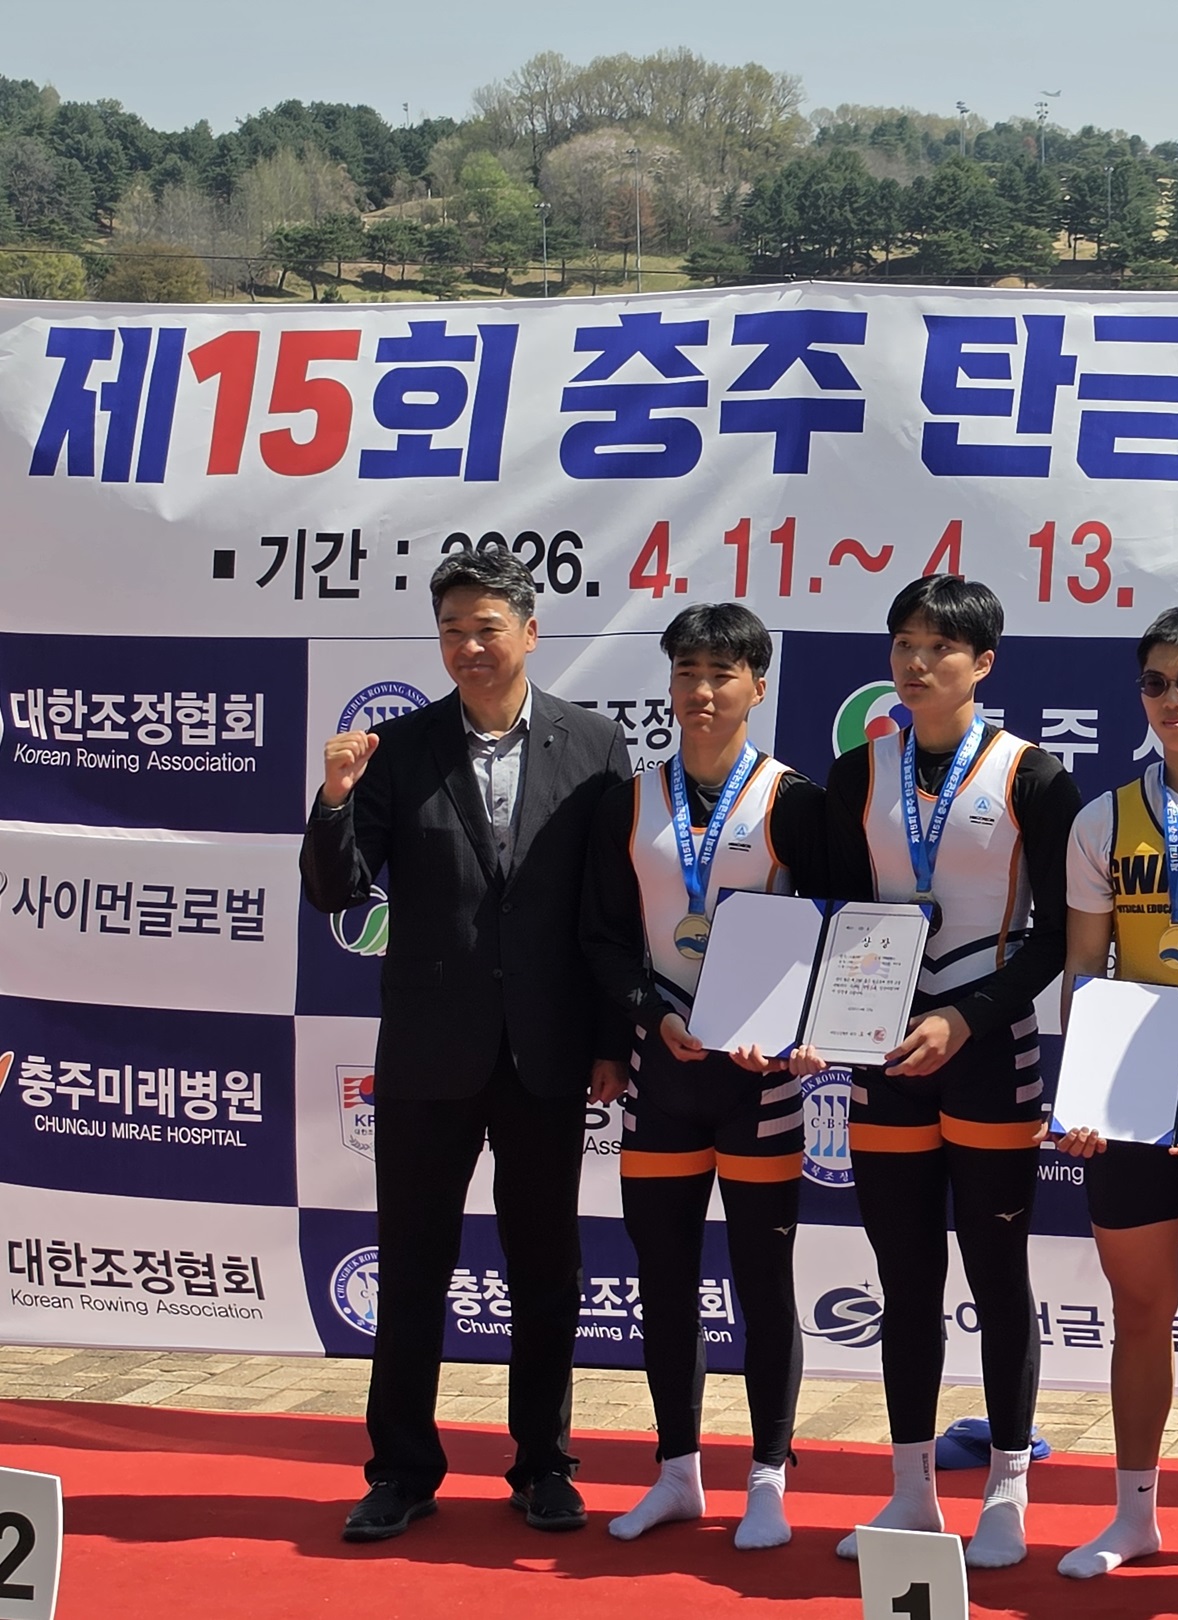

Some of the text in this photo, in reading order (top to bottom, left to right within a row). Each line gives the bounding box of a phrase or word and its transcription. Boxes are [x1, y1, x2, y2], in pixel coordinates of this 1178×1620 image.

[28, 320, 519, 483] 제15회
[558, 310, 868, 480] 충주
[256, 528, 367, 601] 기간
[441, 530, 599, 598] 26.
[921, 520, 966, 582] 4
[1029, 520, 1134, 608] 13.
[9, 687, 266, 748] 대한조정협회
[340, 692, 367, 733] HUNGBUK
[368, 684, 405, 697] ROWING
[13, 743, 257, 773] Korean Rowing Association
[12, 875, 266, 942] 사이먼글로벌
[17, 1055, 263, 1122] 충주미래병원
[34, 1114, 247, 1147] CHUNGJU MIRAE HOSPITAL
[7, 1237, 267, 1302] 대한조정협회
[10, 1288, 264, 1321] Korean Rowing Association
[0, 1511, 36, 1600] 2
